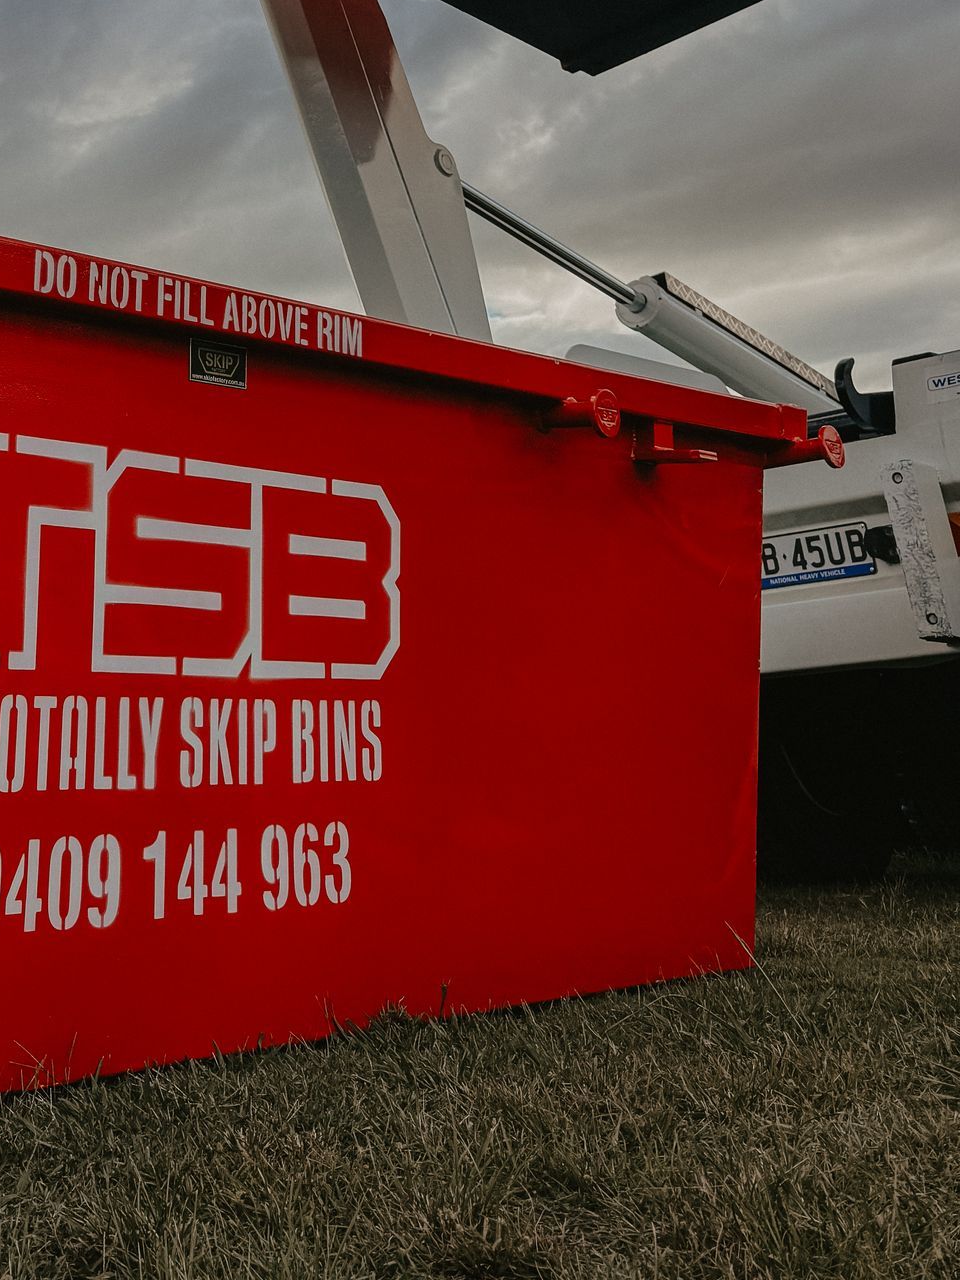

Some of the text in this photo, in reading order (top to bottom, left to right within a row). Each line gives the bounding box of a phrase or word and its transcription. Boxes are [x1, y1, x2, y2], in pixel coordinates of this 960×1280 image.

[33, 249, 363, 357] DO NOT FILL ABOVE RIM
[205, 352, 234, 369] SKIP
[769, 568, 846, 585] NATIONAL HEAVY VEHICLE
[179, 696, 277, 788] SKIP
[292, 699, 383, 784] BINS
[143, 827, 242, 920] 144
[260, 821, 352, 911] 963
